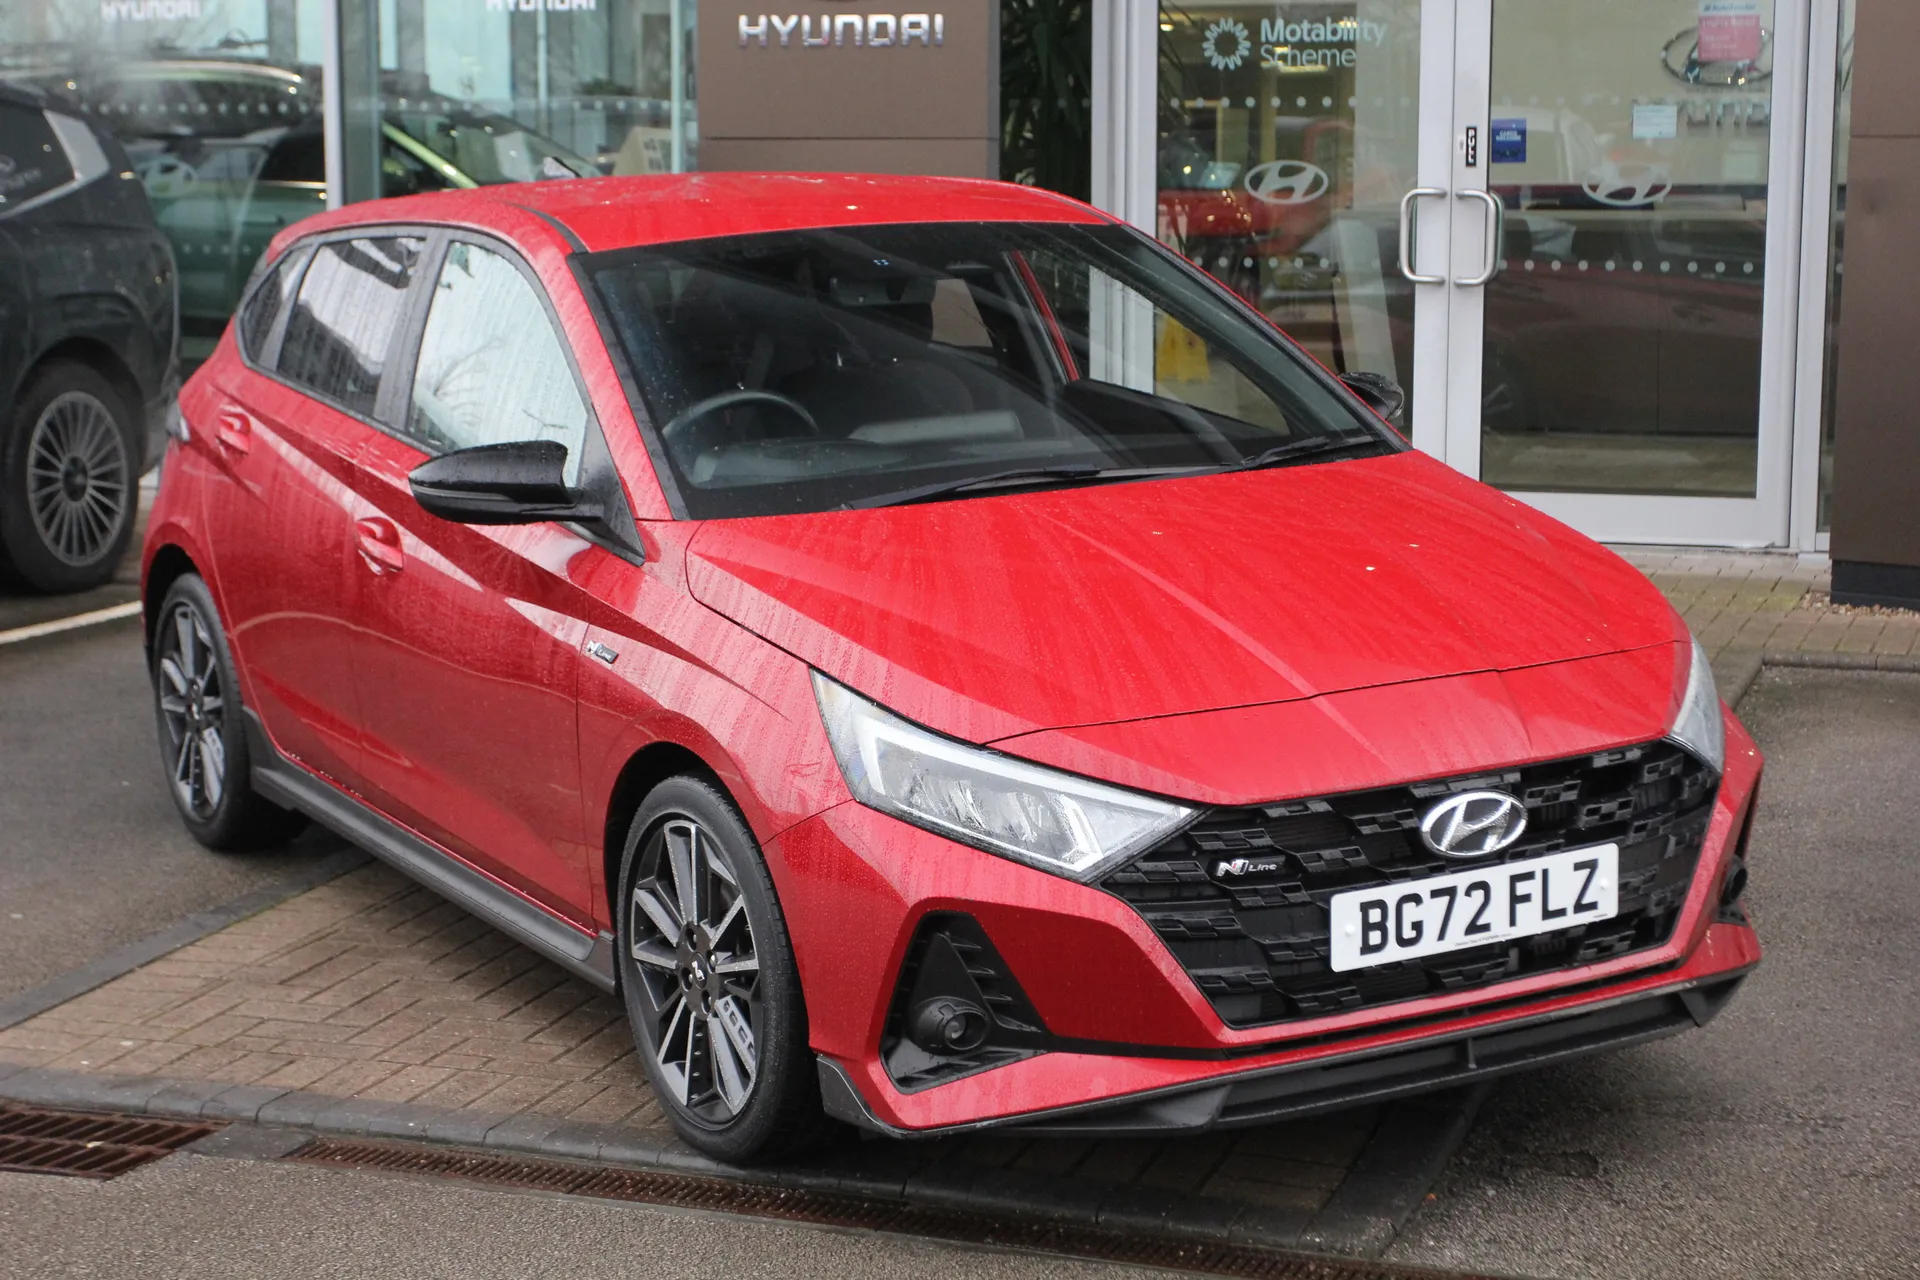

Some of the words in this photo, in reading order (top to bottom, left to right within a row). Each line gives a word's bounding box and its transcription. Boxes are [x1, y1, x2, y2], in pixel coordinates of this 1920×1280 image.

[100, 0, 201, 20] HYUNDAI
[738, 13, 944, 47] HYUNDAI
[1260, 16, 1388, 47] Motability
[1260, 44, 1357, 67] Scheme
[1360, 880, 1491, 955] BG72
[1509, 858, 1599, 928] FLZ
